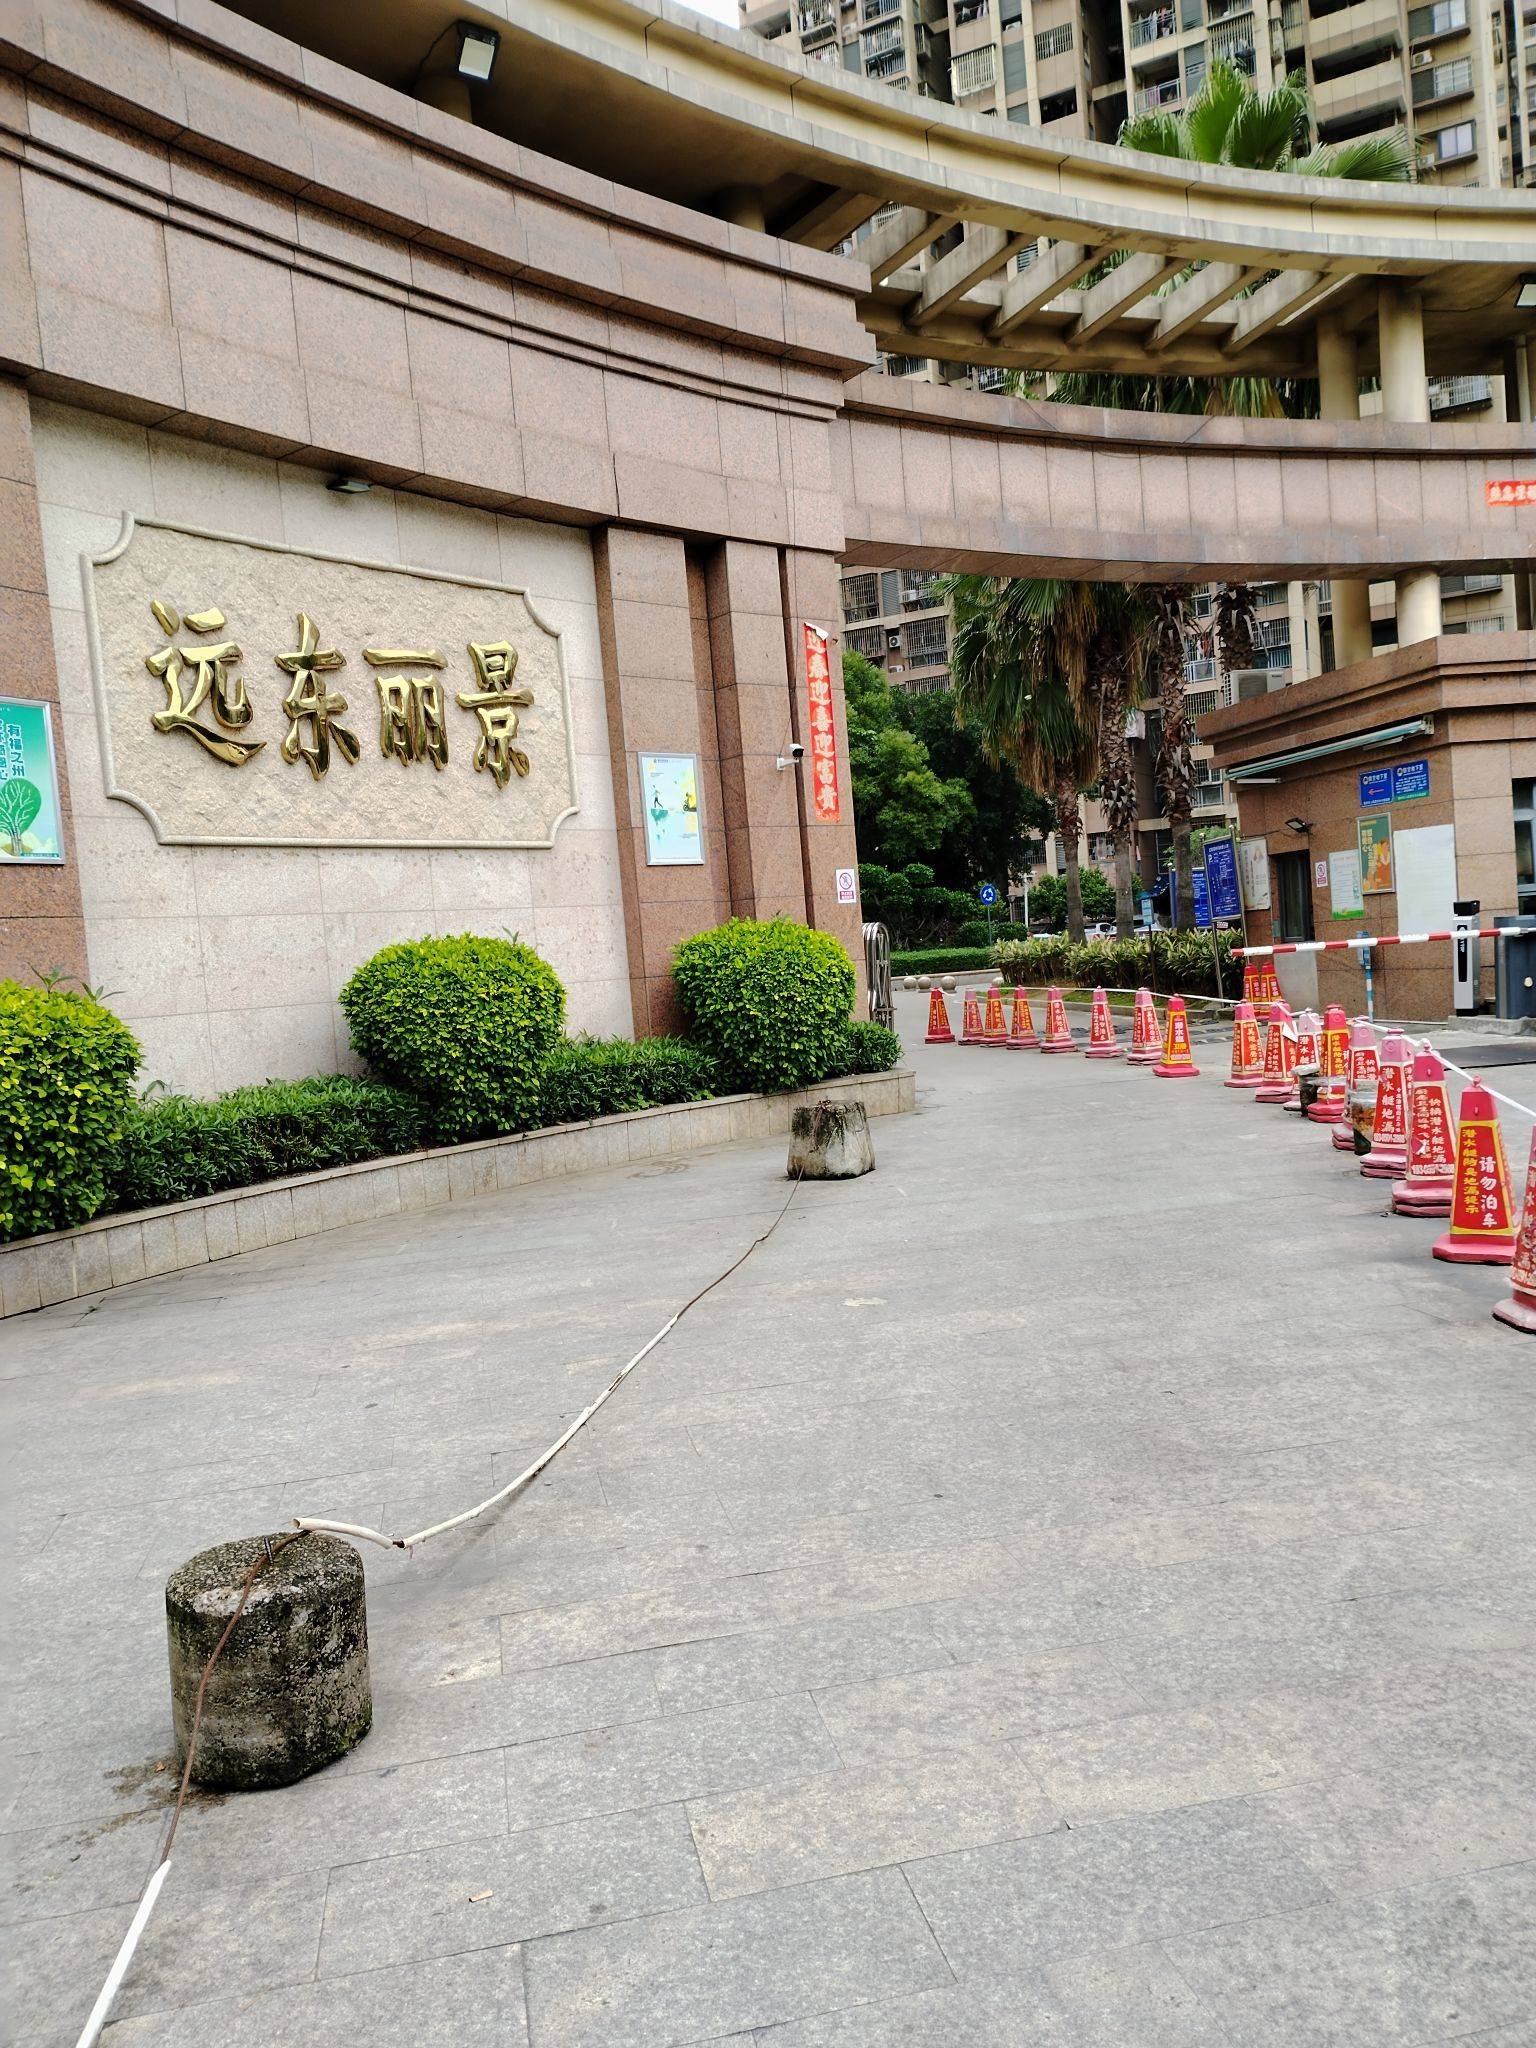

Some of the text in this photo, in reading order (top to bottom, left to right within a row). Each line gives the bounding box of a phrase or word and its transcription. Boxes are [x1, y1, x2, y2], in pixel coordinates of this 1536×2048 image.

[144, 600, 535, 790] 远东丽景
[7, 724, 25, 777] 有福之州
[1381, 1067, 1395, 1133] 潜水艇地漏
[1462, 1128, 1480, 1214] 潜水艇防臭地漏提示
[1479, 1156, 1498, 1228] 请勿泊车
